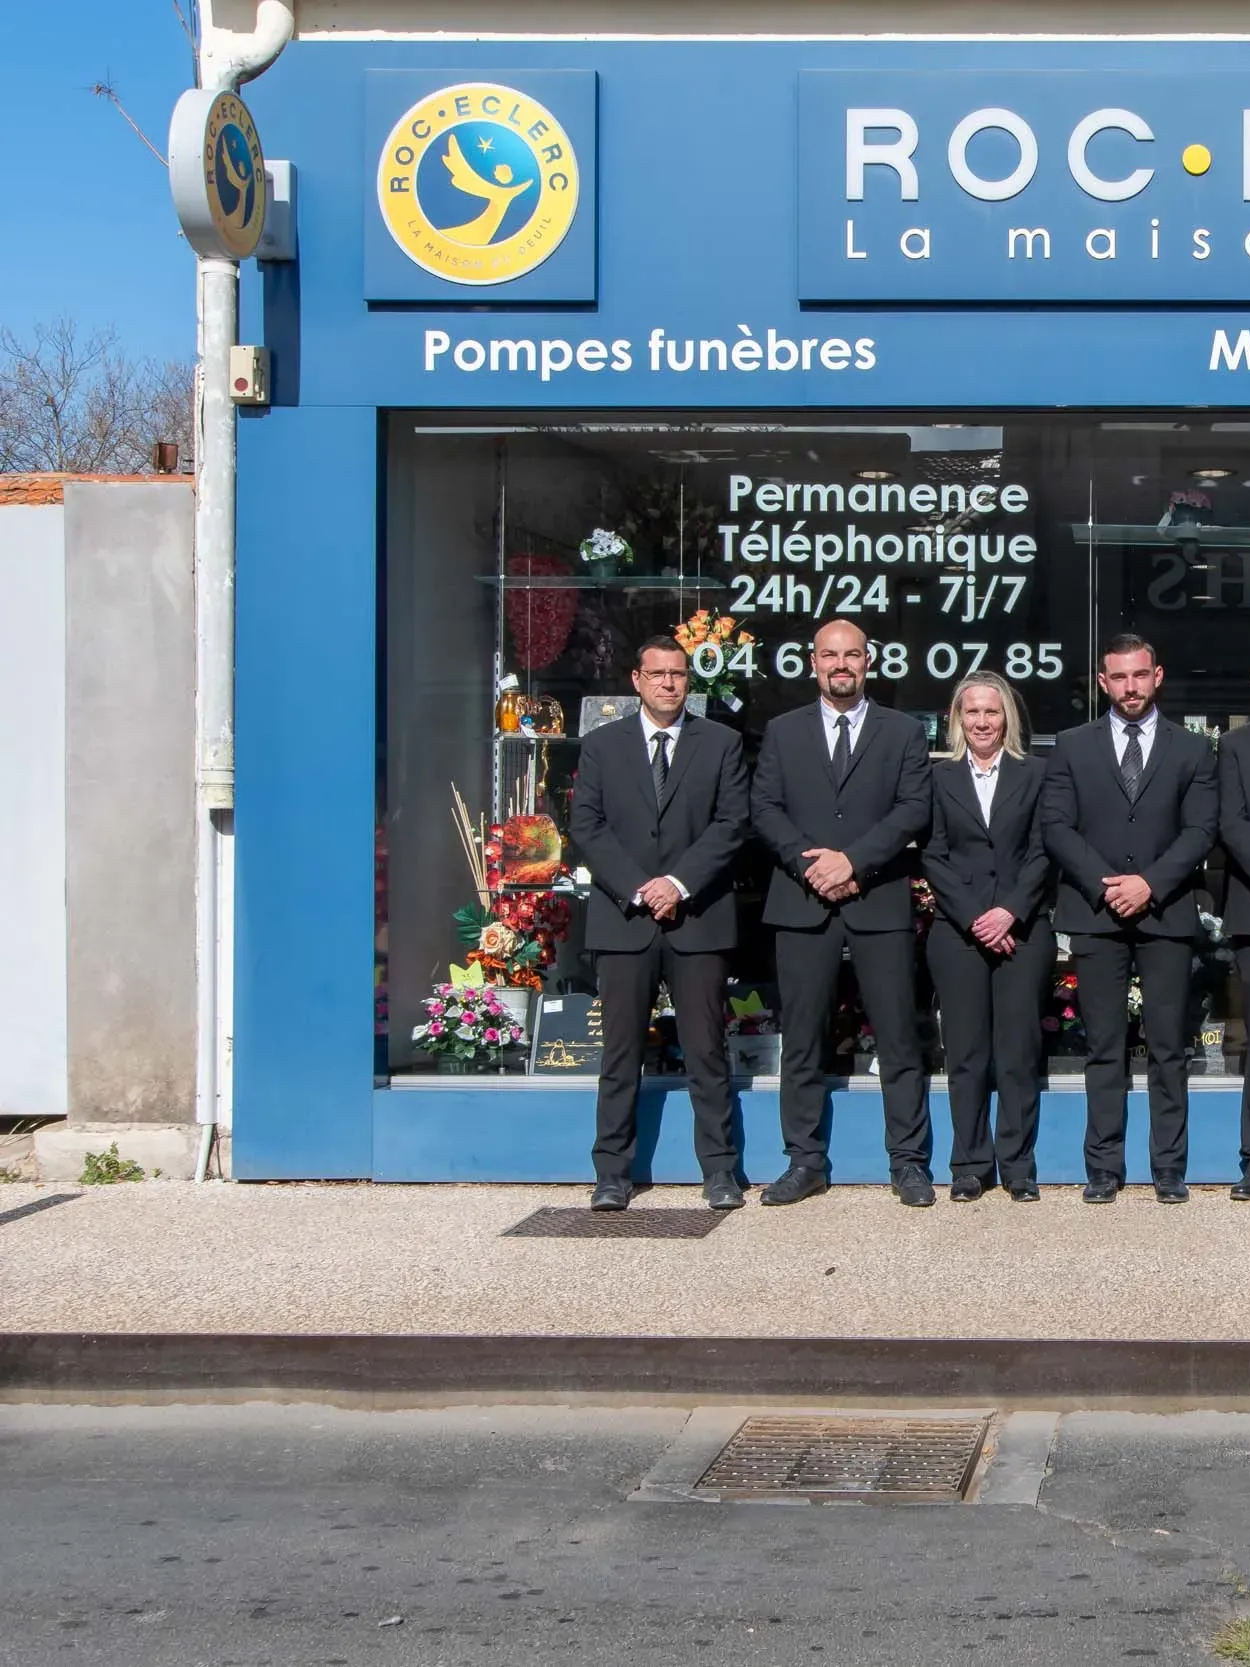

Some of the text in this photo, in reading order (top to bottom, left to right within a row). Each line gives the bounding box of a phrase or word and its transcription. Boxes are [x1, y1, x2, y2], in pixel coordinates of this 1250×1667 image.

[390, 95, 569, 193] ROC ECLERC
[846, 108, 1156, 203] ROC
[846, 219, 931, 260] La
[424, 324, 876, 381] Pompes funèbres
[729, 474, 1030, 513] Permanence
[717, 519, 1038, 572] Téléphonique
[729, 573, 890, 619] 24h/24
[938, 574, 1027, 623] 7j/7
[692, 641, 758, 679] 04
[926, 641, 989, 679] 07
[1004, 641, 1064, 680] 85
